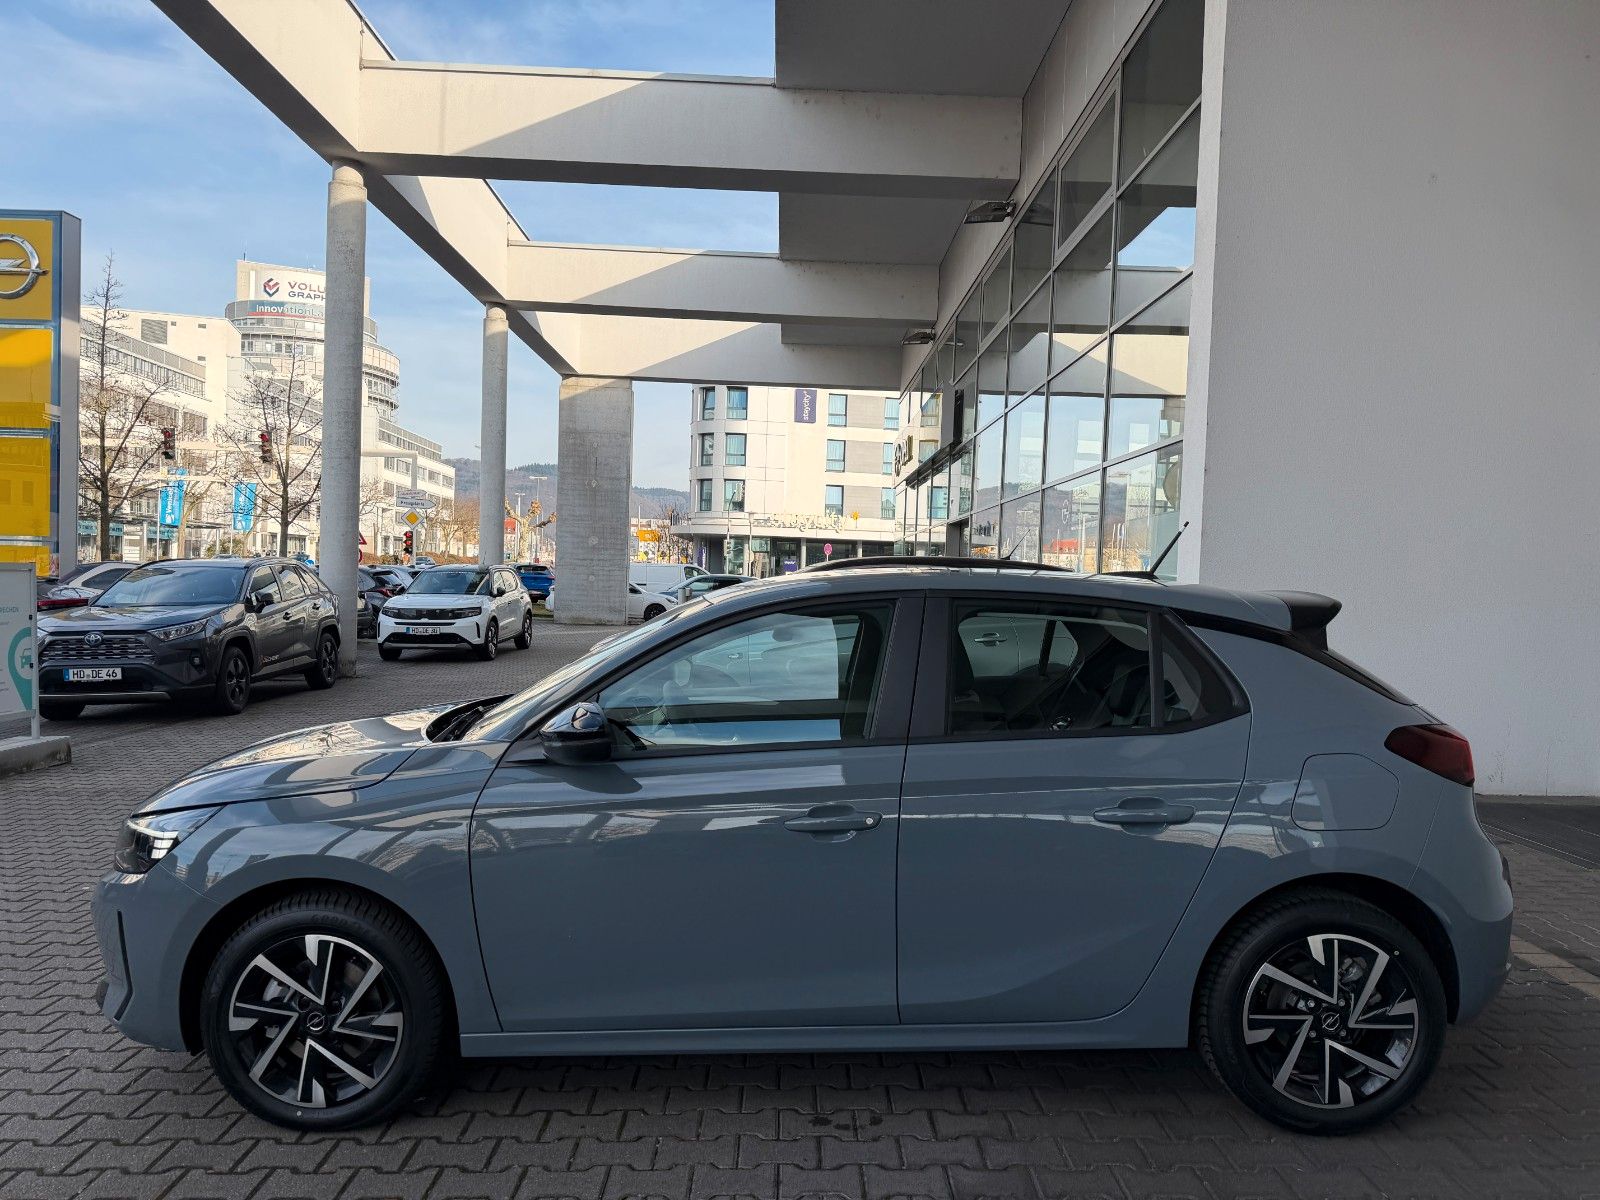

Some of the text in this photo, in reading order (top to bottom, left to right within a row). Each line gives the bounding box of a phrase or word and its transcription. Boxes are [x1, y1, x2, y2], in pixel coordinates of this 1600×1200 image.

[72, 669, 118, 679] HD DE 46
